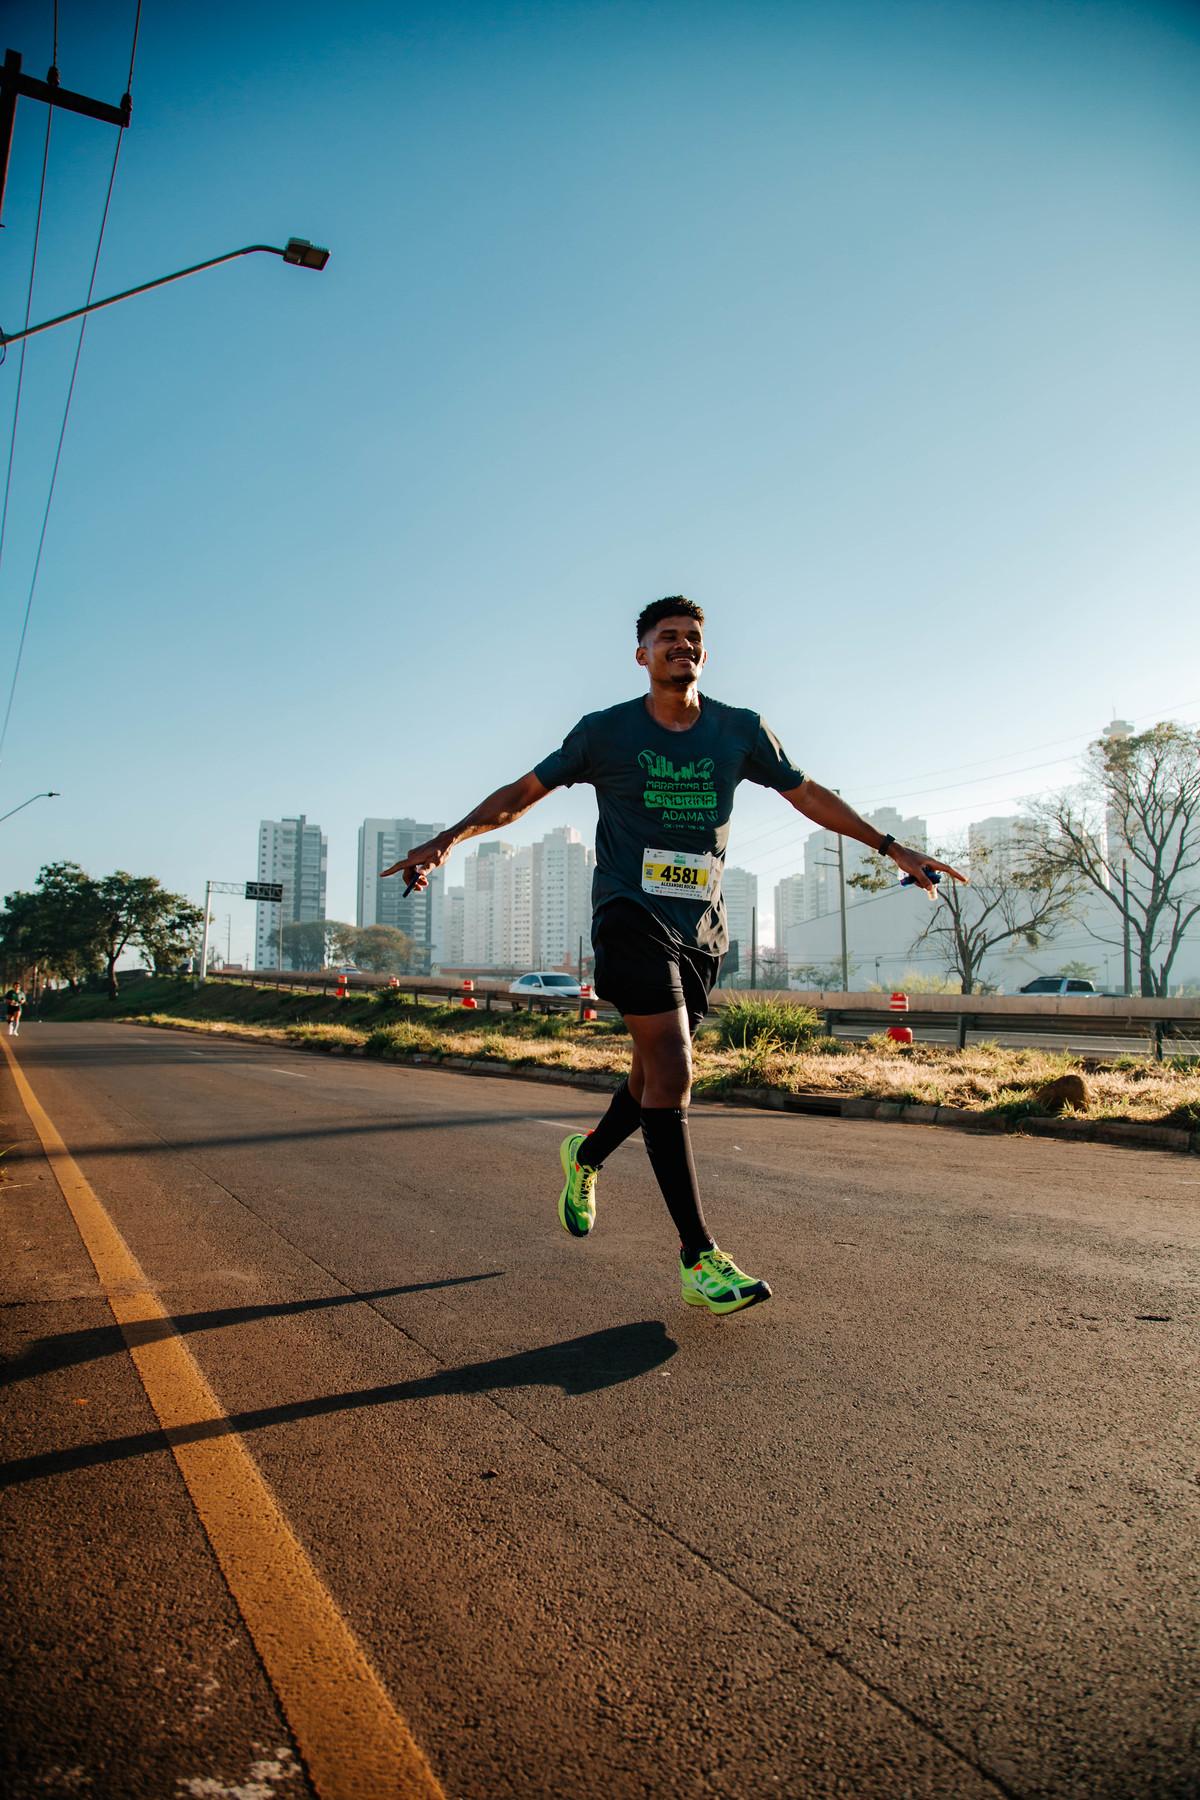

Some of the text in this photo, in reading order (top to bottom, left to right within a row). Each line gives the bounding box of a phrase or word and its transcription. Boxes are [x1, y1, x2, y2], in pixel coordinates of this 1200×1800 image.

[646, 780, 714, 791] MARATONA DE
[662, 810, 705, 822] ADAMA
[660, 865, 698, 885] 4581
